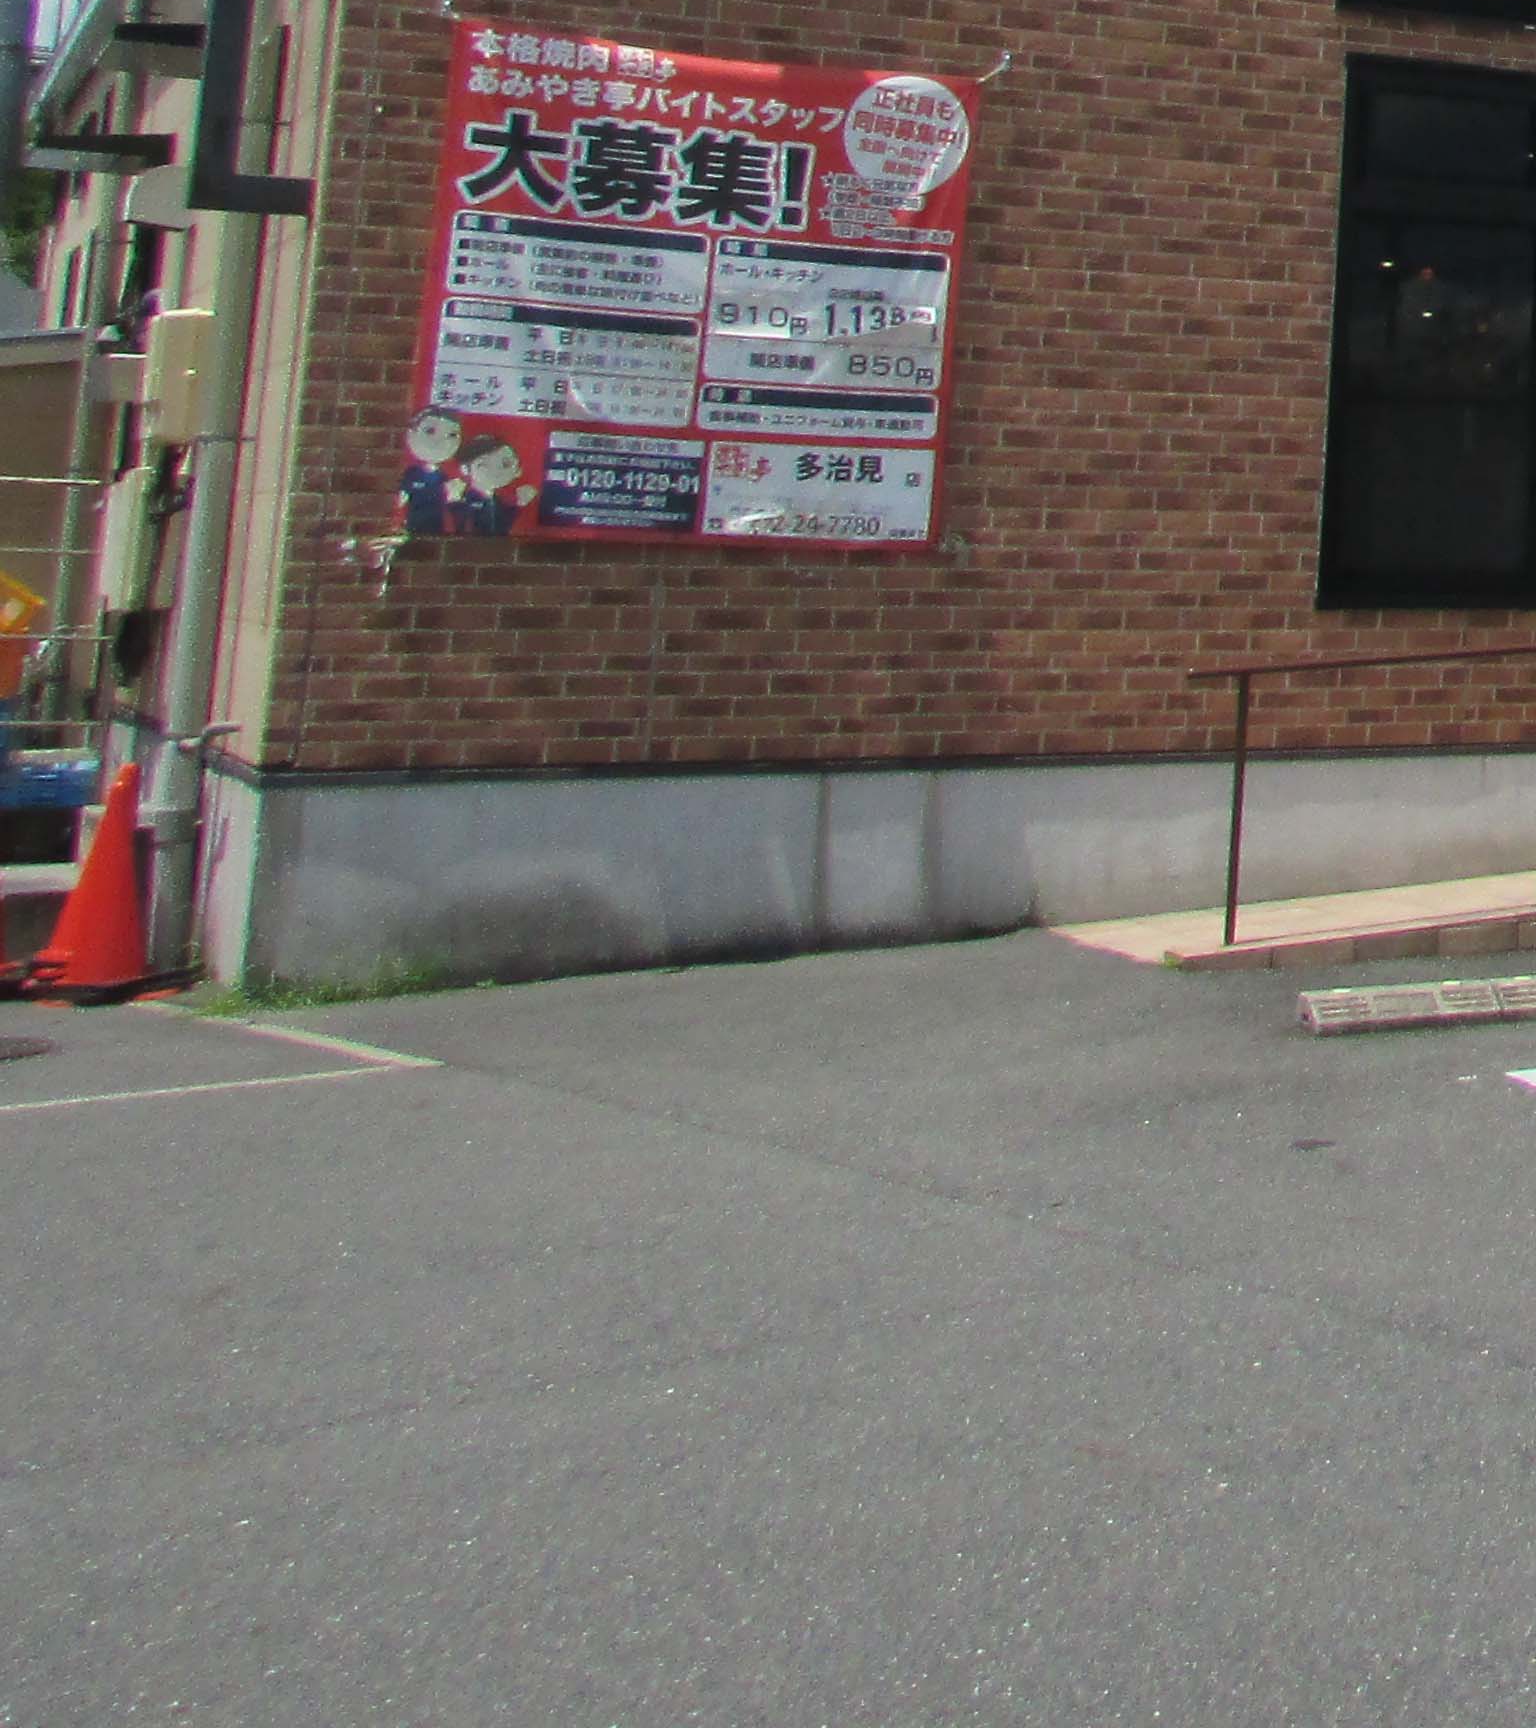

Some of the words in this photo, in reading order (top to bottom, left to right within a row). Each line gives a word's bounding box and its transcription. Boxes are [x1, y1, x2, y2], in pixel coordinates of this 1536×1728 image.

[472, 28, 611, 72] 本格焼肉
[467, 64, 846, 132] あみやき亭バイトスタッフ
[794, 451, 885, 483] 多治見
